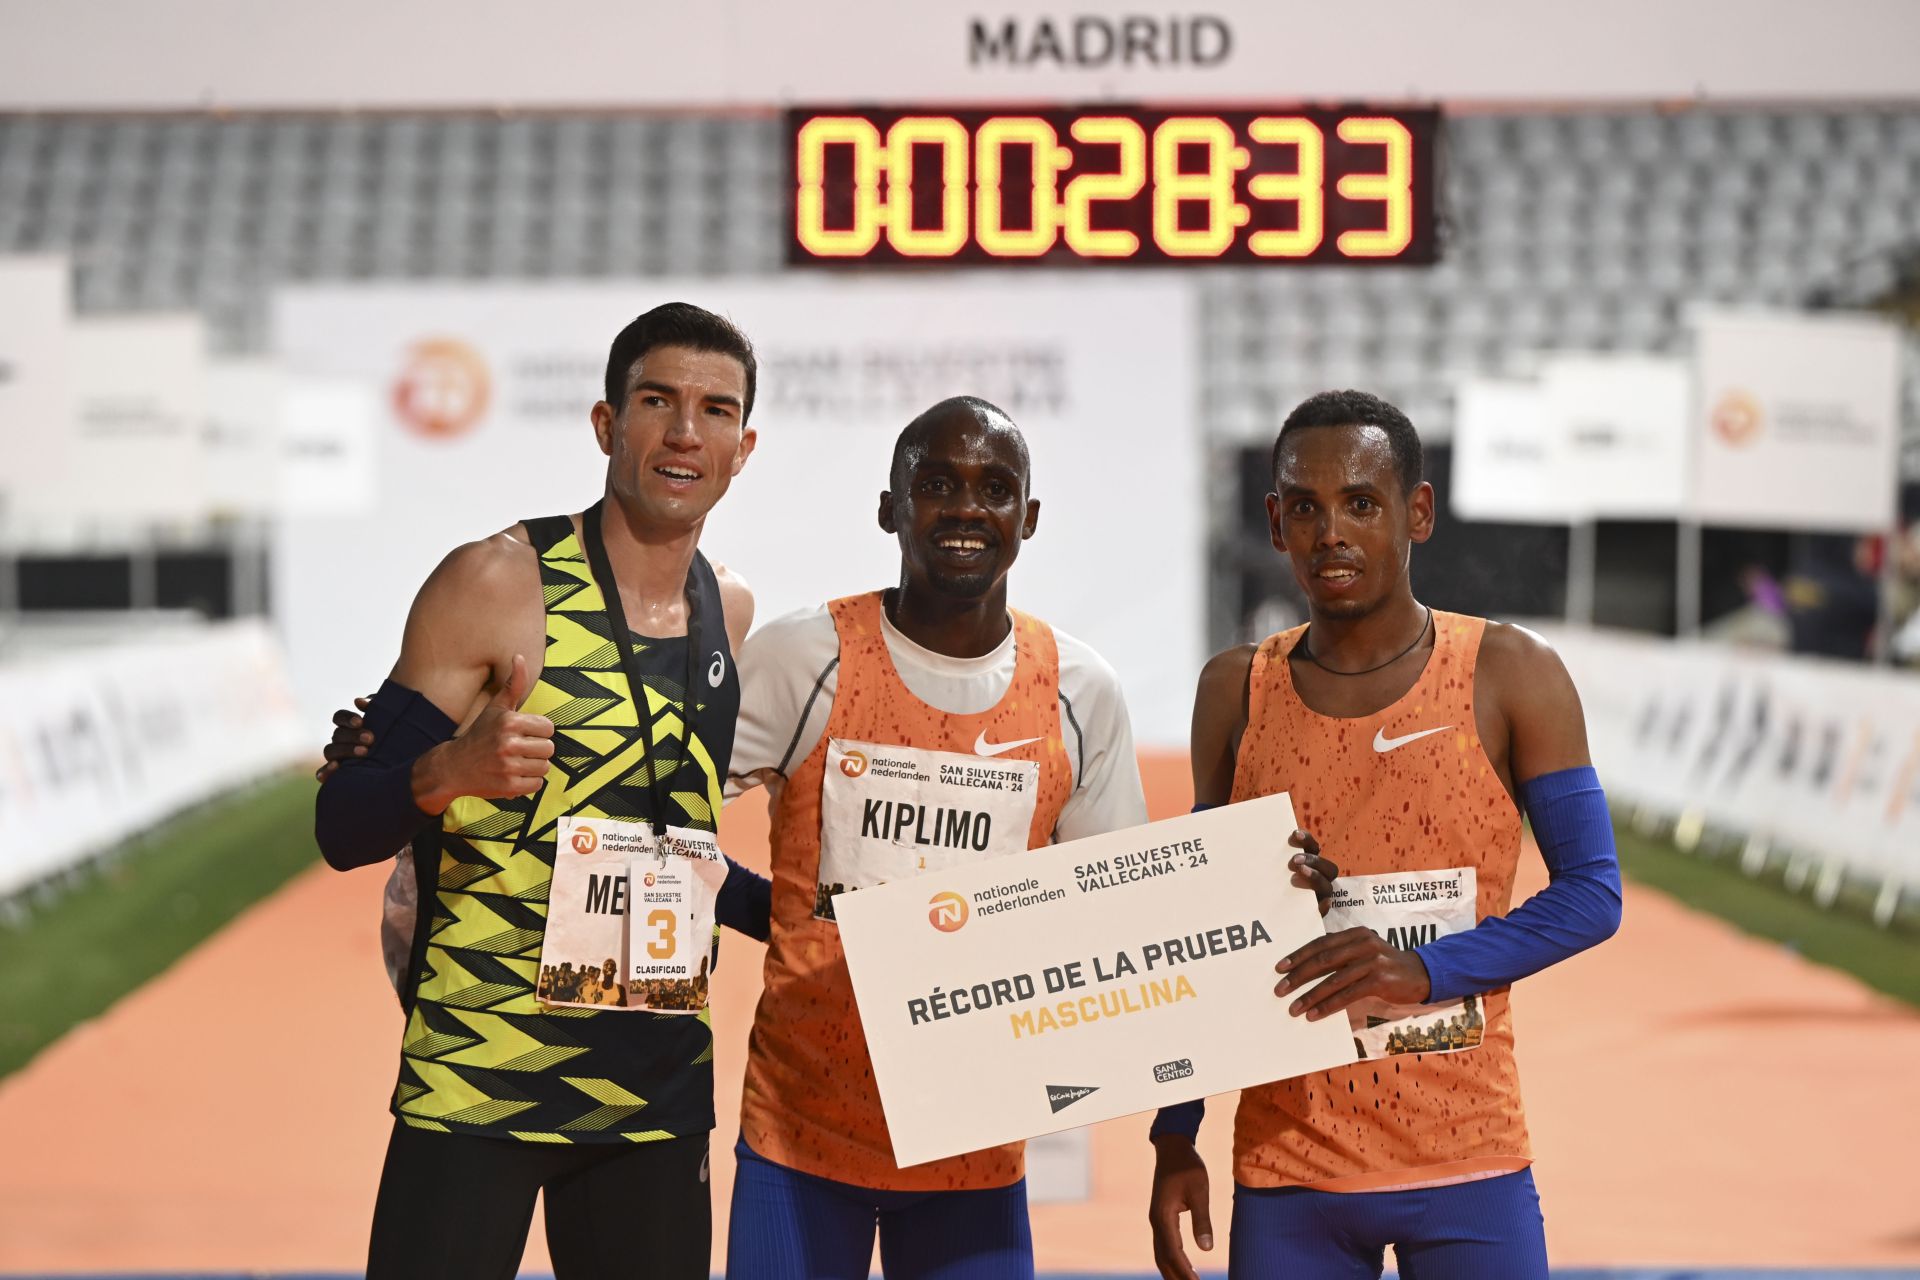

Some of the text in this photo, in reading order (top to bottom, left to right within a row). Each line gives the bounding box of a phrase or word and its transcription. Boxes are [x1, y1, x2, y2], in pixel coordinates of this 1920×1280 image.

[969, 16, 1233, 68] MADRID
[871, 757, 917, 770] nationale
[870, 767, 930, 782] nederlanden
[940, 764, 1025, 783] SAN SILVESTRE
[939, 774, 1023, 793] VALLECANA 24
[861, 798, 992, 852] KIPLIMO
[602, 832, 643, 843] nationale
[673, 838, 716, 852] SILVESTRE
[602, 842, 654, 854] nederlanden
[708, 852, 718, 861] 24
[918, 856, 926, 869] 1
[1073, 838, 1205, 880] SAN SILVESTRE
[1076, 853, 1209, 894] VALLECANA 24
[973, 878, 1040, 903] nationale
[1372, 879, 1458, 895] SAN SILVESTRE
[977, 887, 1066, 917] nederlanden
[1372, 890, 1459, 905] VALLECANA 24
[646, 909, 677, 960] 3
[635, 965, 687, 974] CLASIFICADO
[907, 919, 1273, 1026] RÉCORD DE LA PRUEBA
[1009, 974, 1197, 1039] MASCULINA
[1155, 1063, 1177, 1075] SANI
[1156, 1067, 1193, 1083] CENTRO
